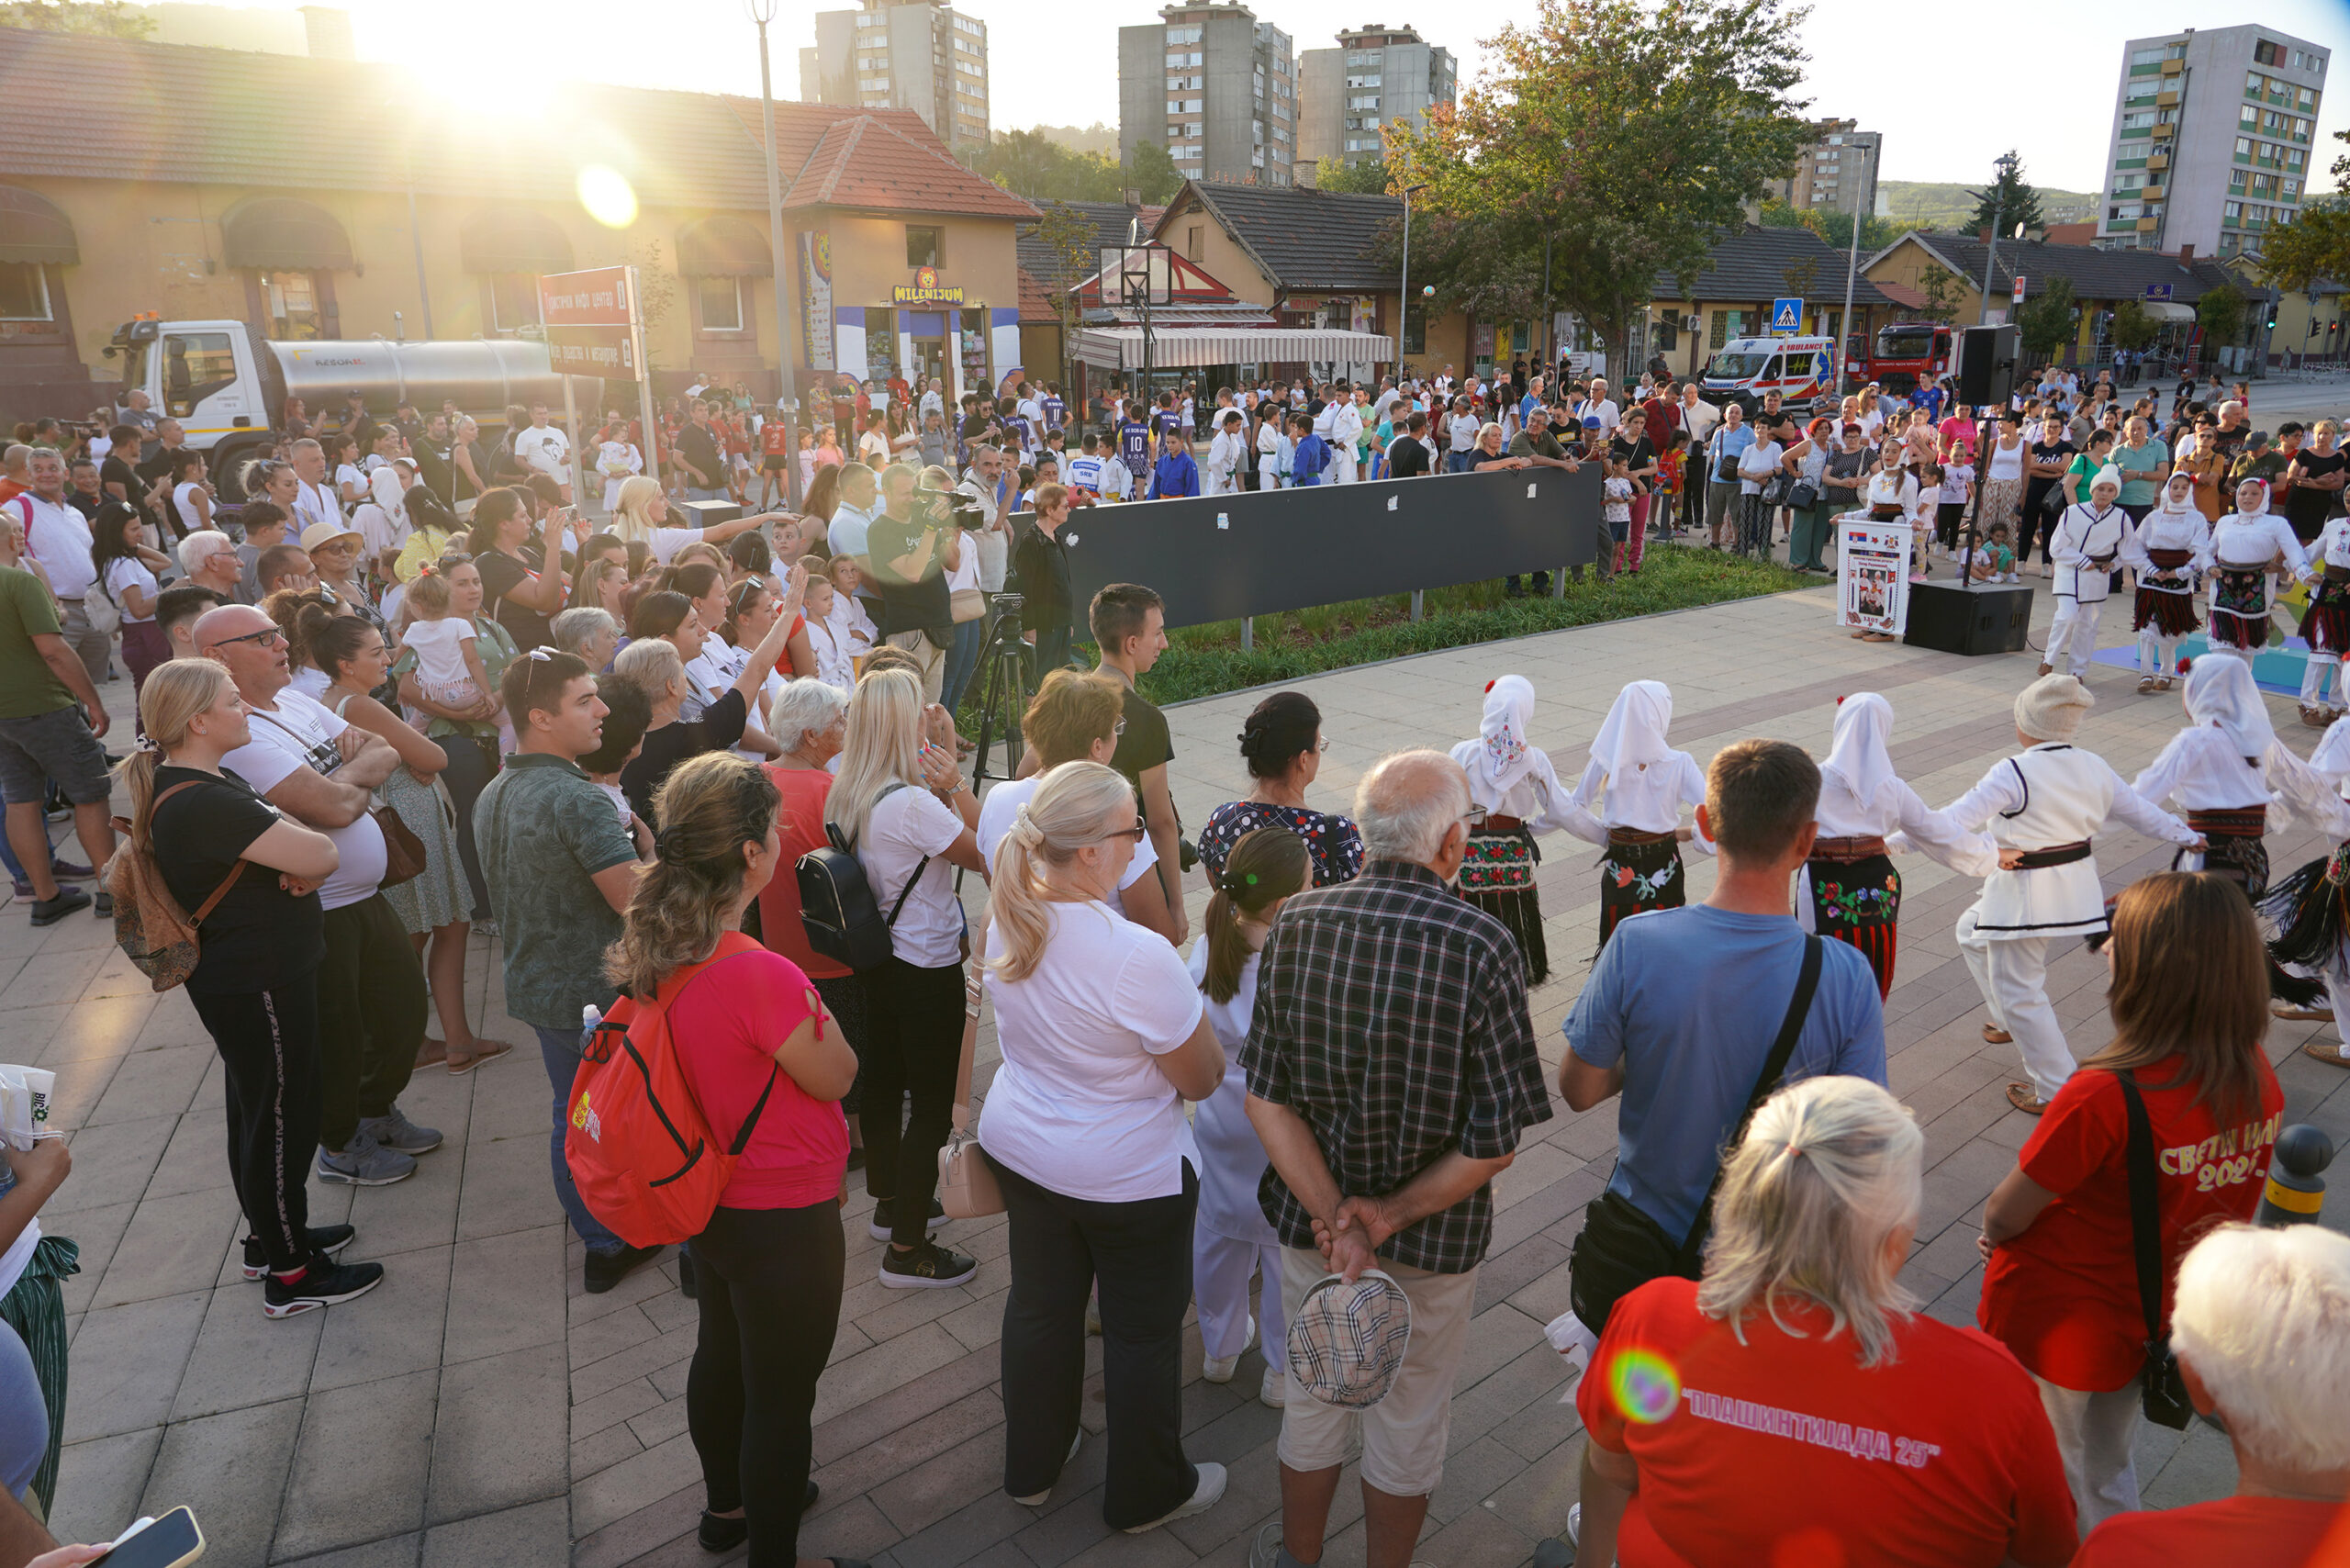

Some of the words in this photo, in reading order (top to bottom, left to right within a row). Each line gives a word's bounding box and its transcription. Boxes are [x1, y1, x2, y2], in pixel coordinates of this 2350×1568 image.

[592, 291, 613, 311] центар
[895, 286, 963, 302] MILENIJUM
[1291, 299, 1319, 309] GRATIS
[1053, 409, 1060, 421] 11
[1130, 436, 1142, 452] 10
